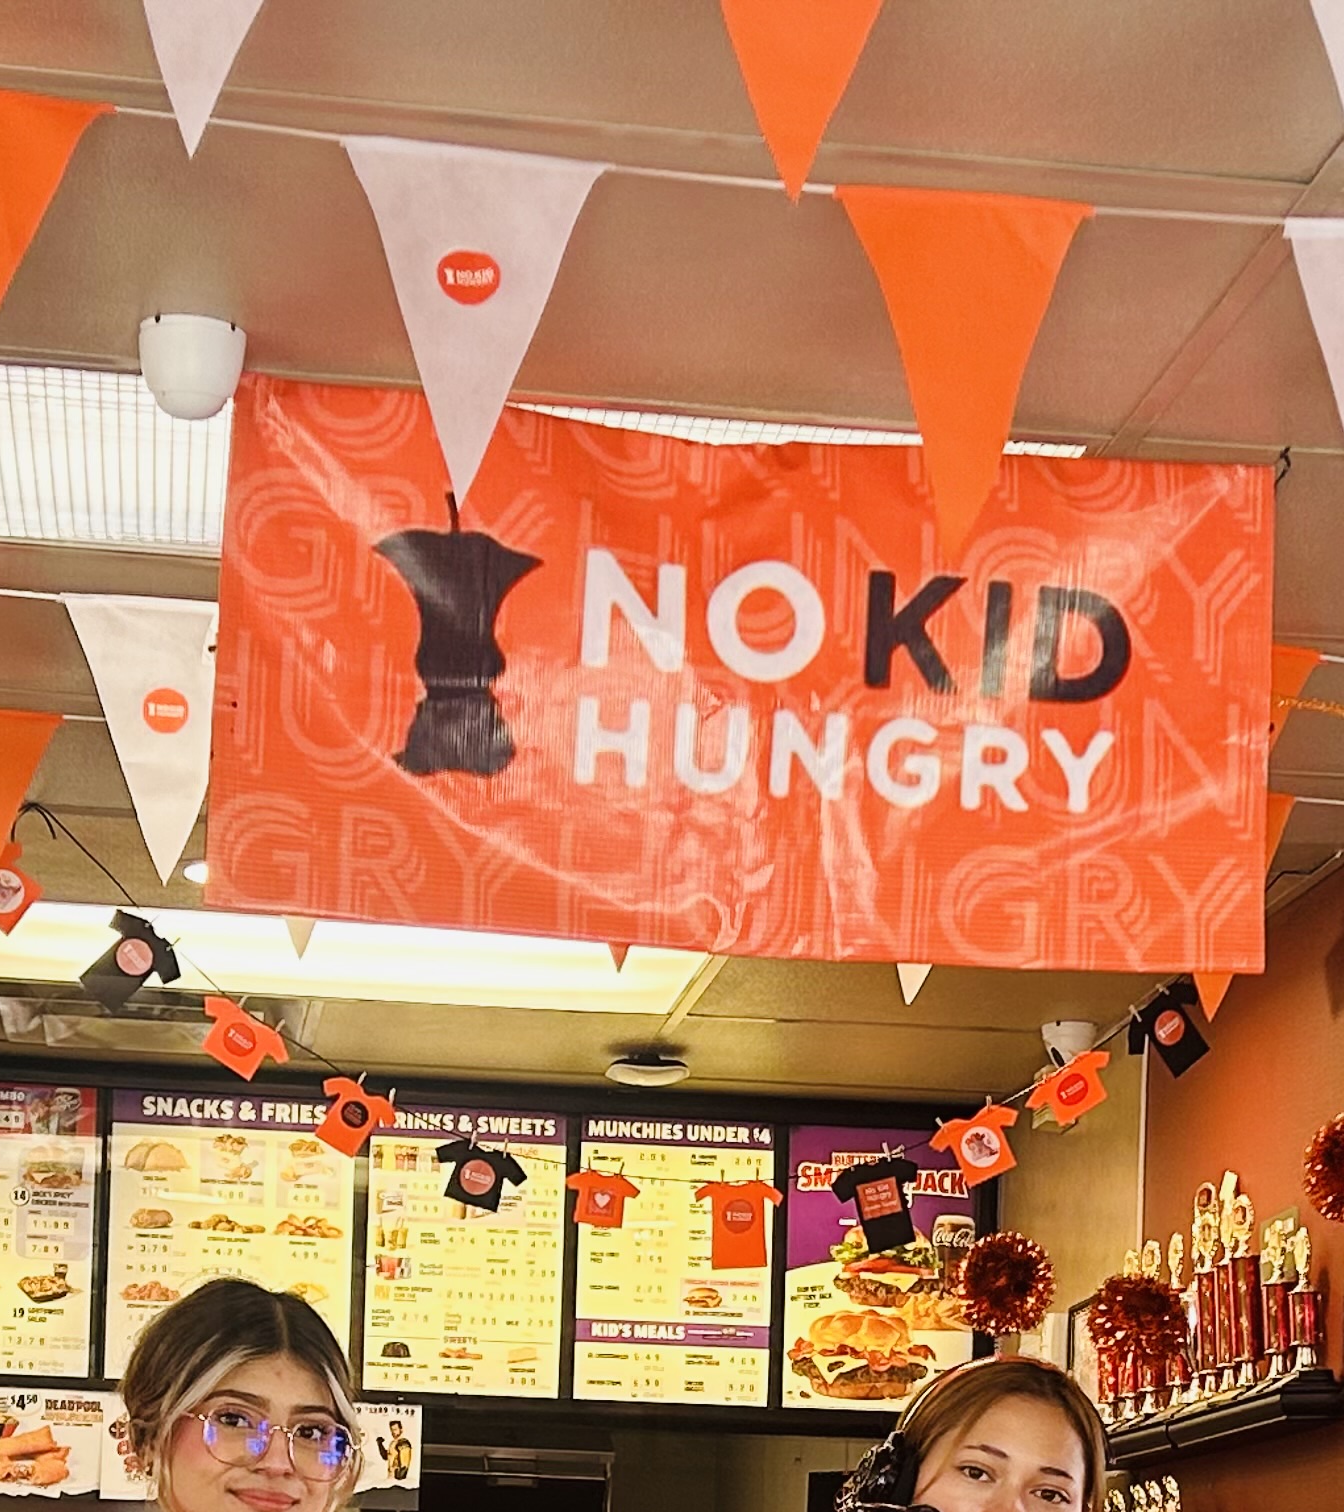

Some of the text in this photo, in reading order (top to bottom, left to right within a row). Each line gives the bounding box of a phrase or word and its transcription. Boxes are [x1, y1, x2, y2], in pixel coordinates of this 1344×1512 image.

[576, 547, 827, 683] NO
[863, 567, 1133, 706] KID
[572, 694, 1118, 816] HUNGRY
[142, 1095, 235, 1121] SNACKS
[237, 1100, 257, 1122] &
[261, 1102, 327, 1125] FRIES
[378, 1111, 455, 1131] RINKS
[457, 1114, 473, 1133] &
[476, 1116, 557, 1137] SWEETS
[588, 1119, 772, 1145] MUNCHIES UNDER $4
[13, 1189, 27, 1201] 14
[916, 1171, 967, 1195] JACK
[12, 1308, 26, 1319] 19
[590, 1321, 686, 1341] KID'S MEALS
